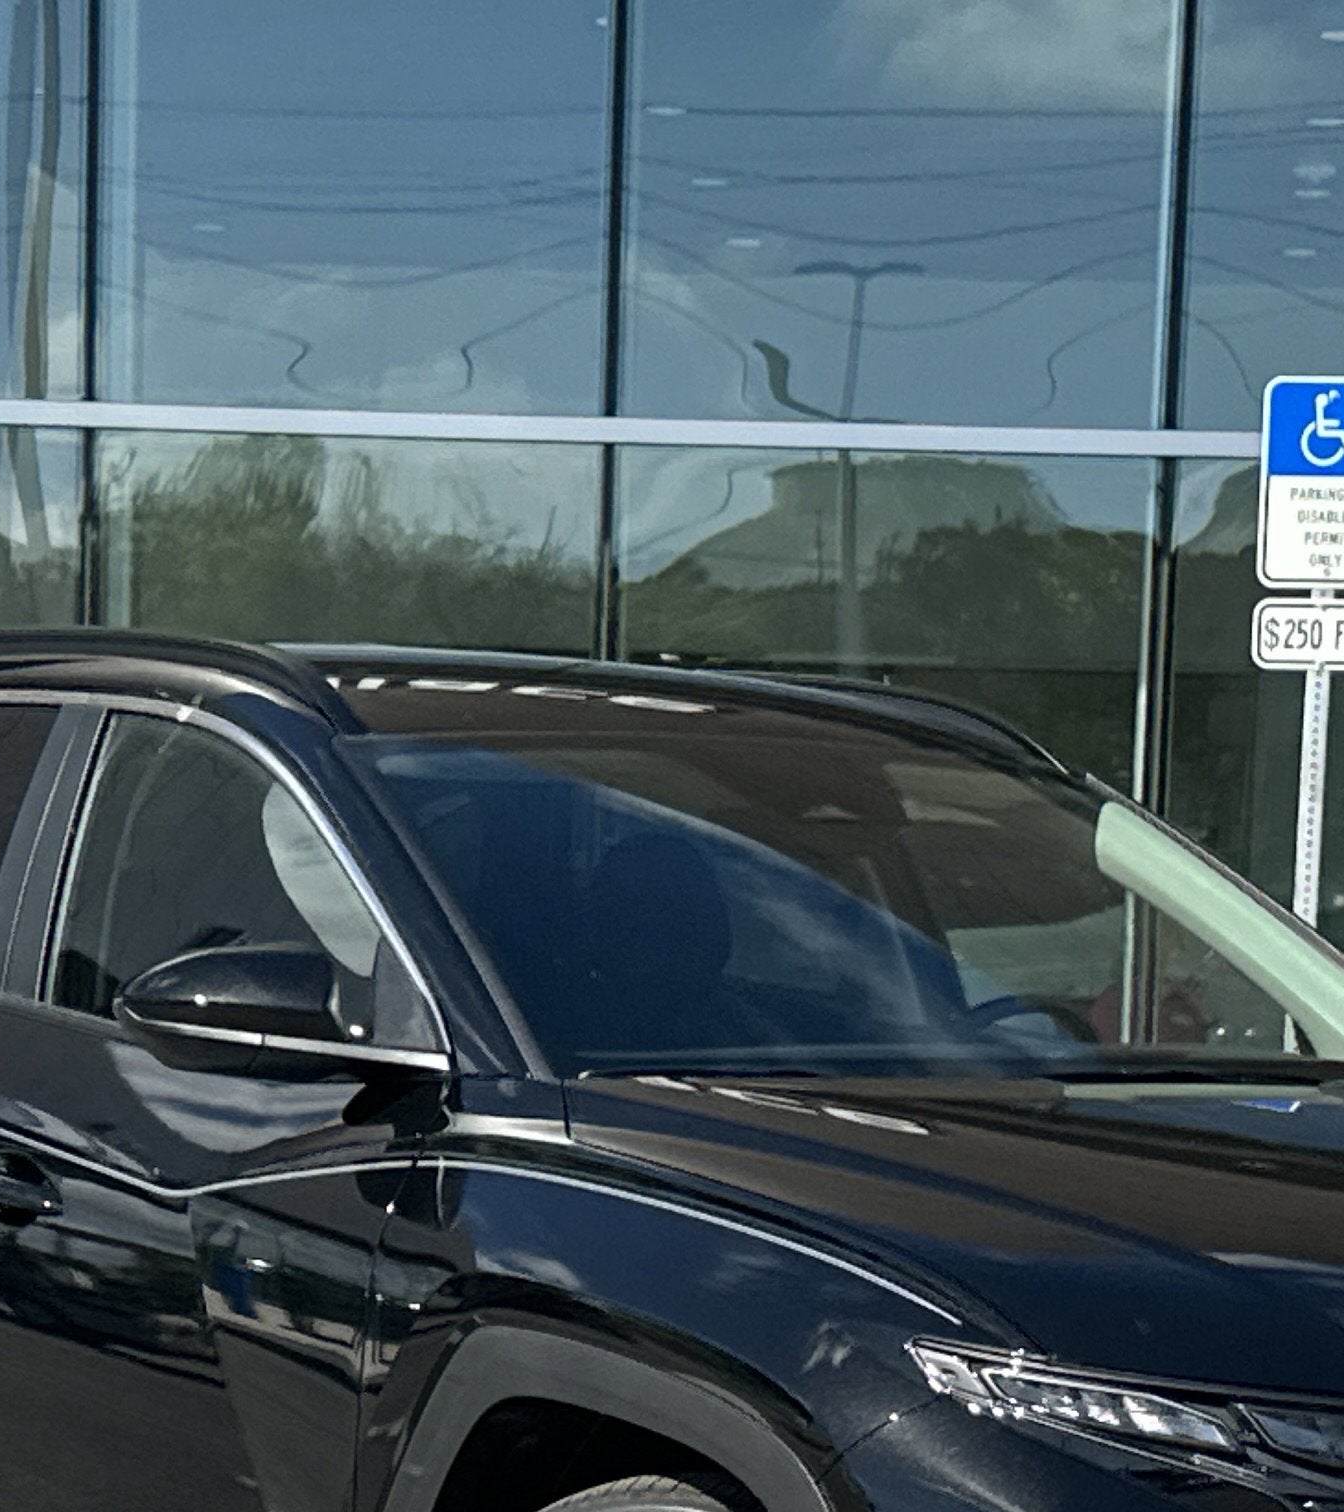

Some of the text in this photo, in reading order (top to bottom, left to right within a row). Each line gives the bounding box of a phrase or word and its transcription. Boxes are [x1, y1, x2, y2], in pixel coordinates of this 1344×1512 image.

[1289, 487, 1344, 502] PARKING
[1309, 553, 1342, 568] ONLY
[1263, 616, 1323, 651] $250
